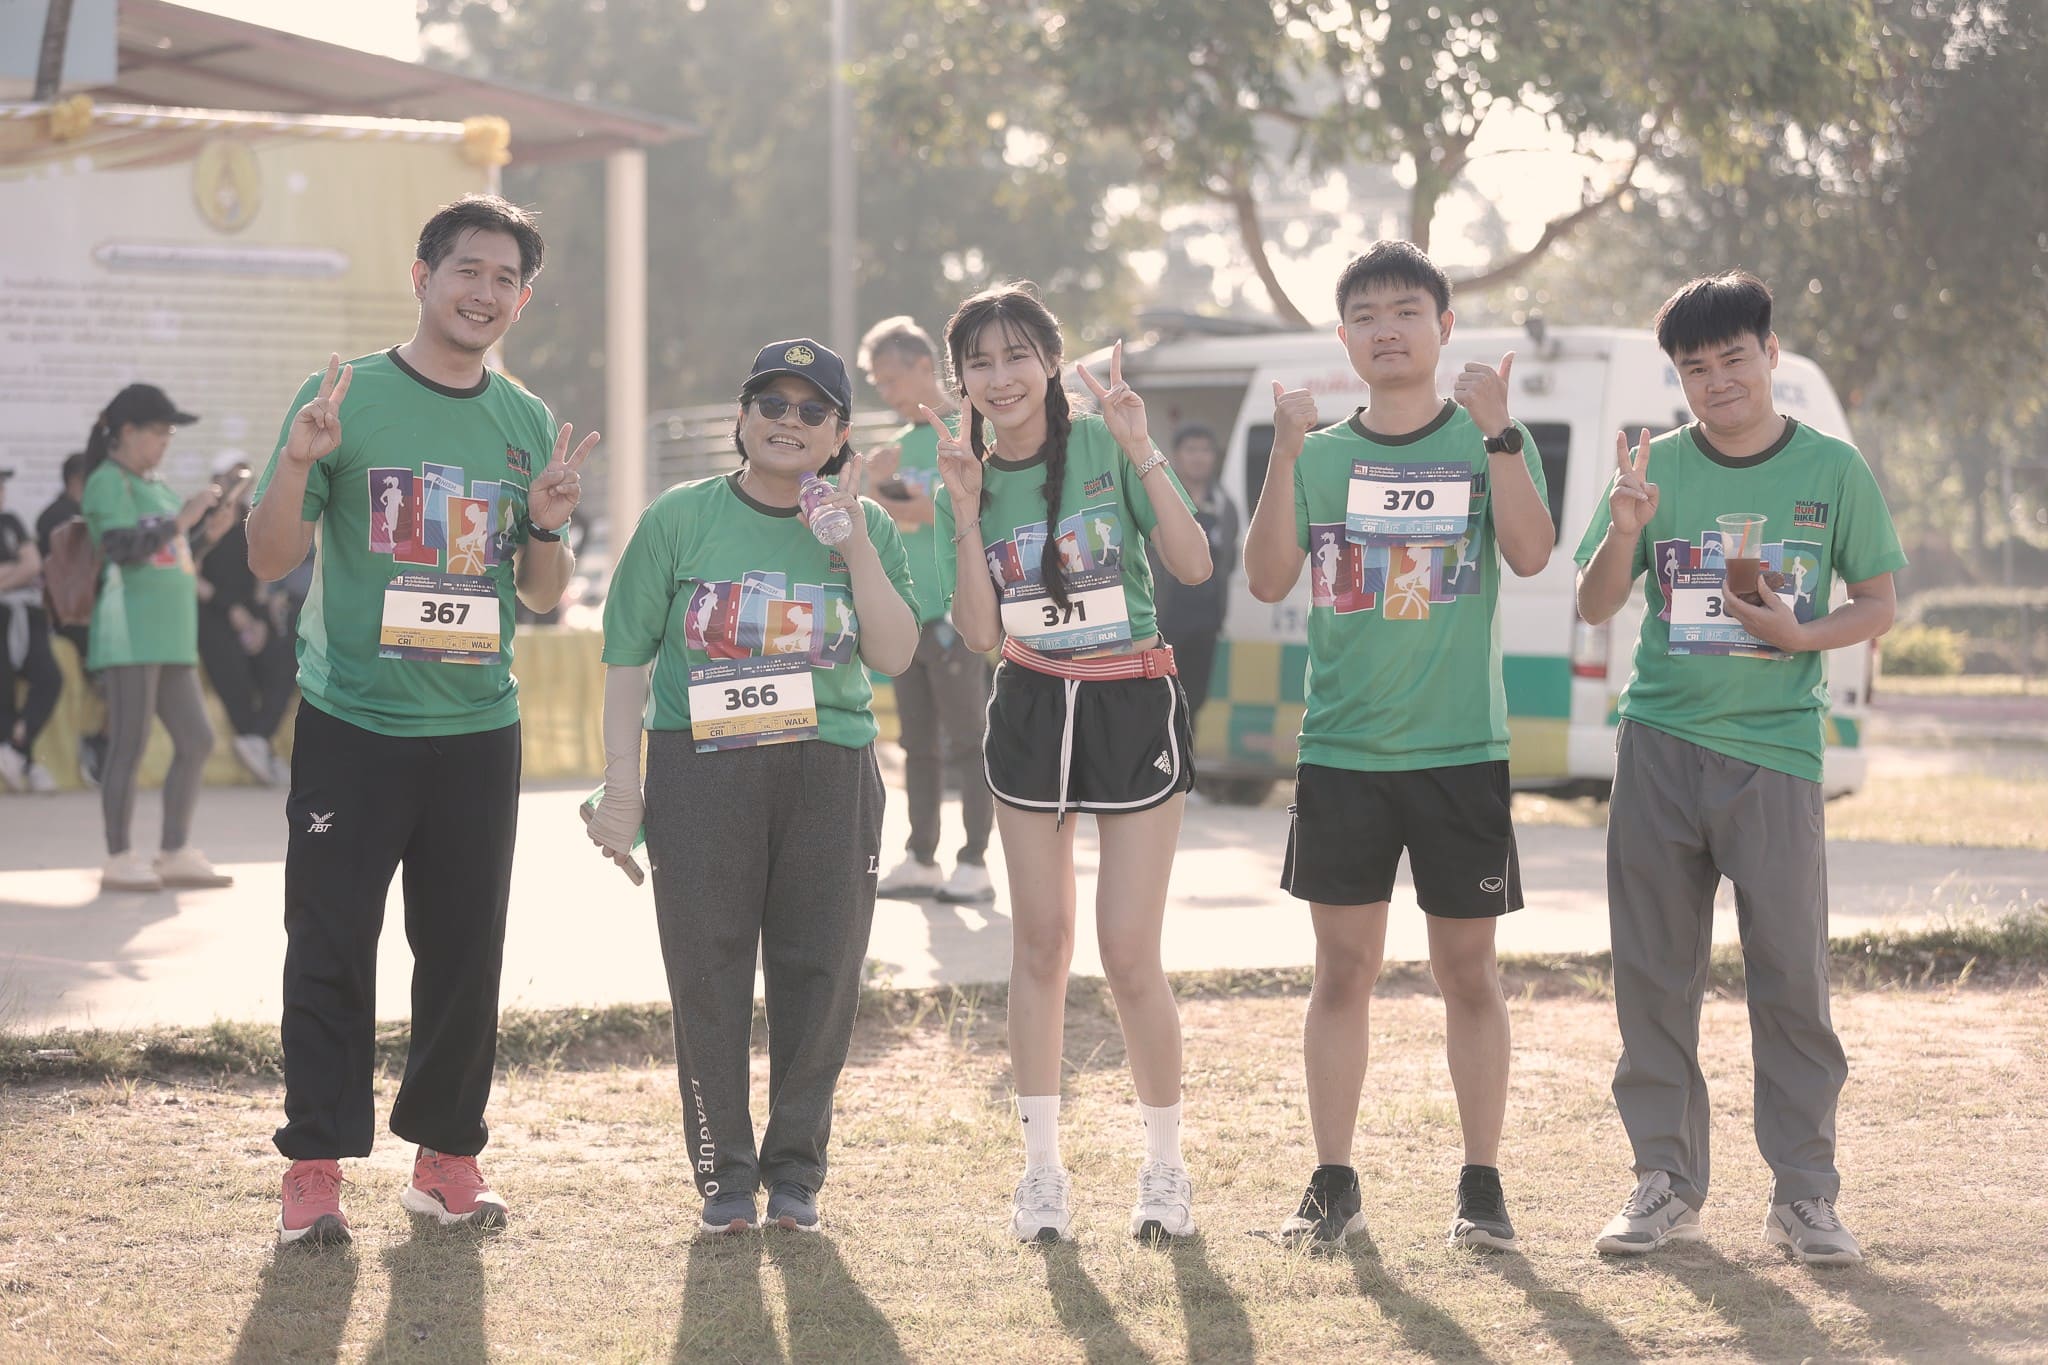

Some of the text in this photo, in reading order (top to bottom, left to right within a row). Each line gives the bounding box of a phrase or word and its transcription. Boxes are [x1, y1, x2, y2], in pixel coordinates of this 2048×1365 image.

[1383, 489, 1435, 511] 370
[1793, 514, 1814, 522] BIKE
[1794, 502, 1829, 523] RUN 11
[1435, 524, 1454, 532] RUN
[420, 600, 470, 625] 367
[1041, 600, 1087, 627] 371
[397, 637, 492, 649] CRI WALK
[1098, 631, 1117, 641] RUN
[1686, 632, 1699, 641] CRI
[724, 684, 778, 711] 366
[710, 716, 809, 737] CRI WALK
[307, 823, 333, 833] FBT
[690, 1077, 716, 1174] LEAGUE
